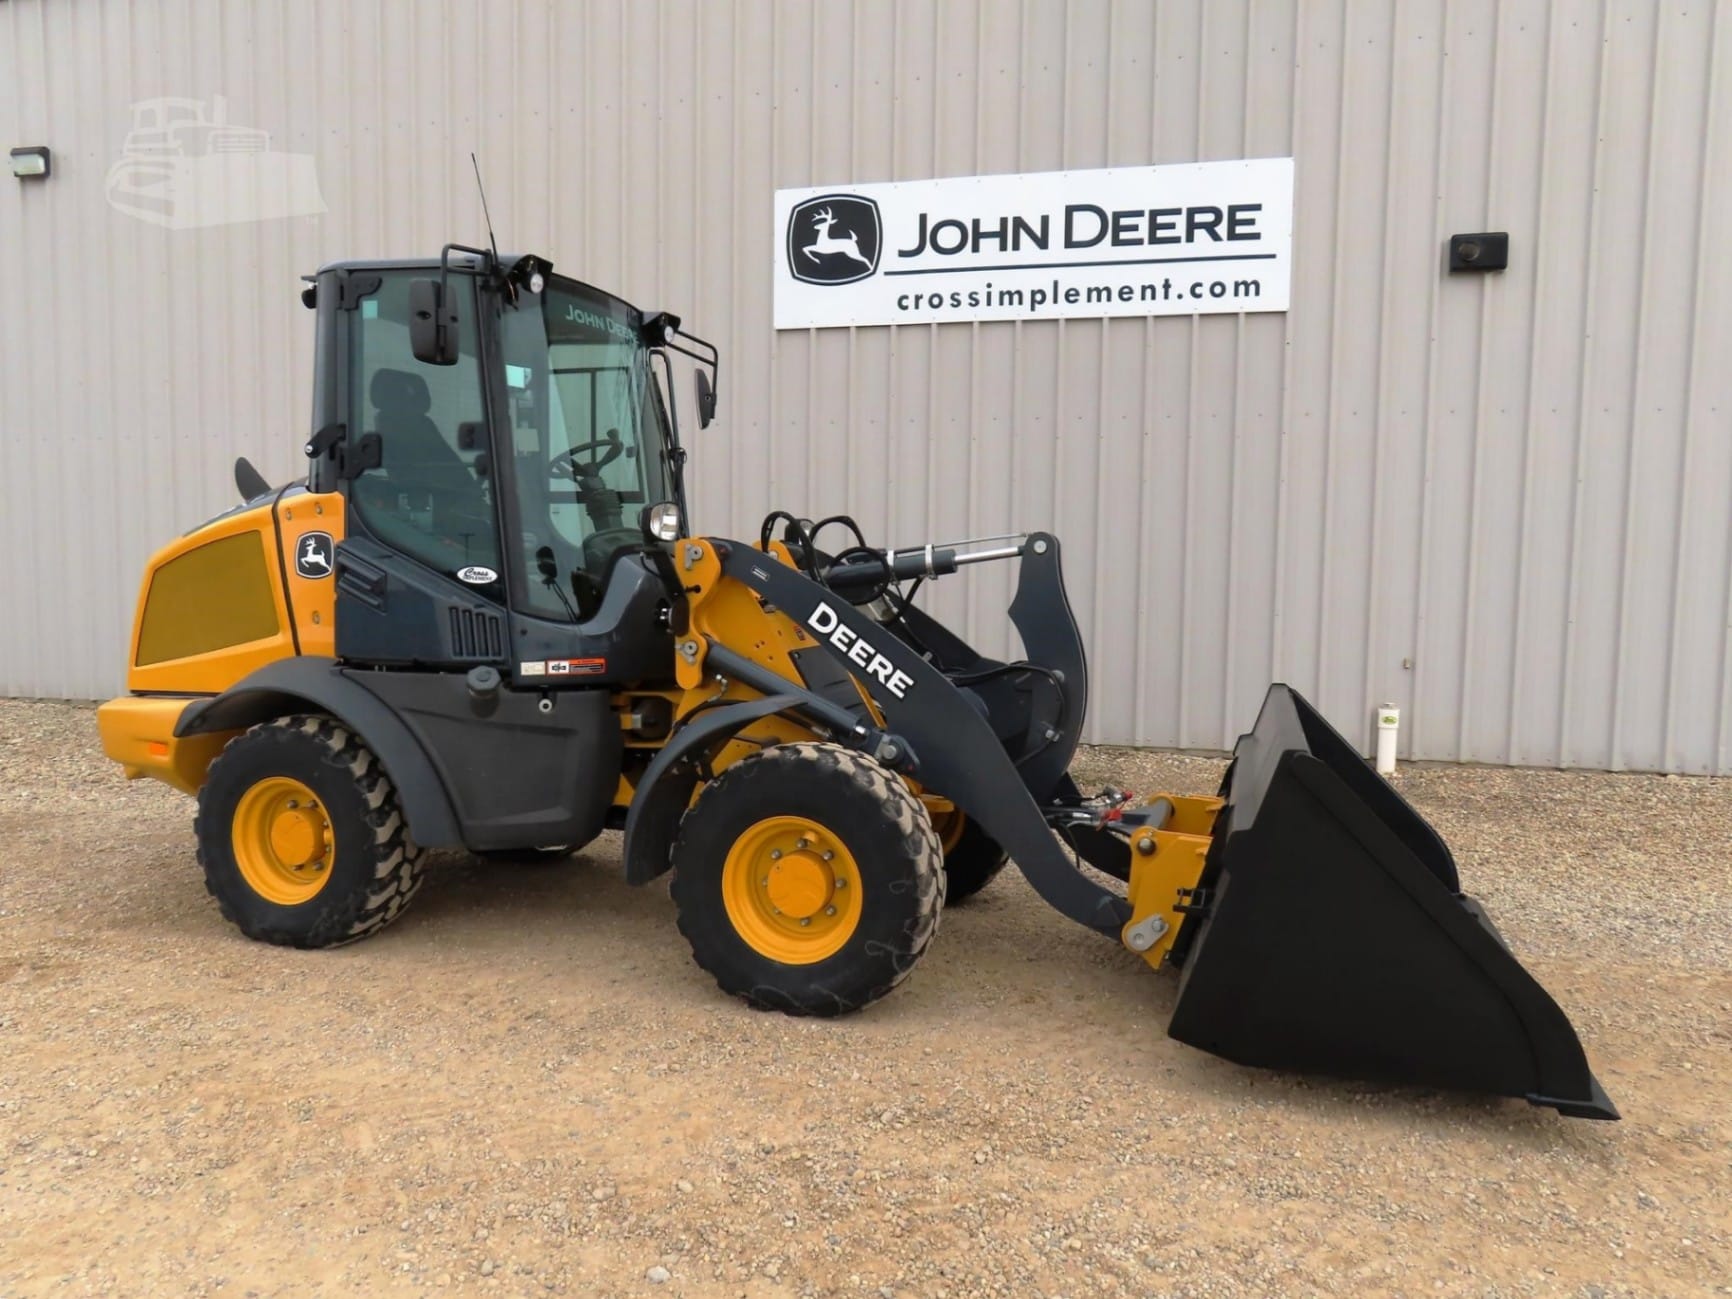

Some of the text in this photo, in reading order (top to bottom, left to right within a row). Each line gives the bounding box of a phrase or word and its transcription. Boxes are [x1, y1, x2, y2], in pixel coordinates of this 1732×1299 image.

[897, 203, 1263, 258] JOHN DEERE
[565, 303, 605, 331] JOHN
[896, 277, 1262, 312] crossimplement.com
[808, 602, 914, 698] DEERE
